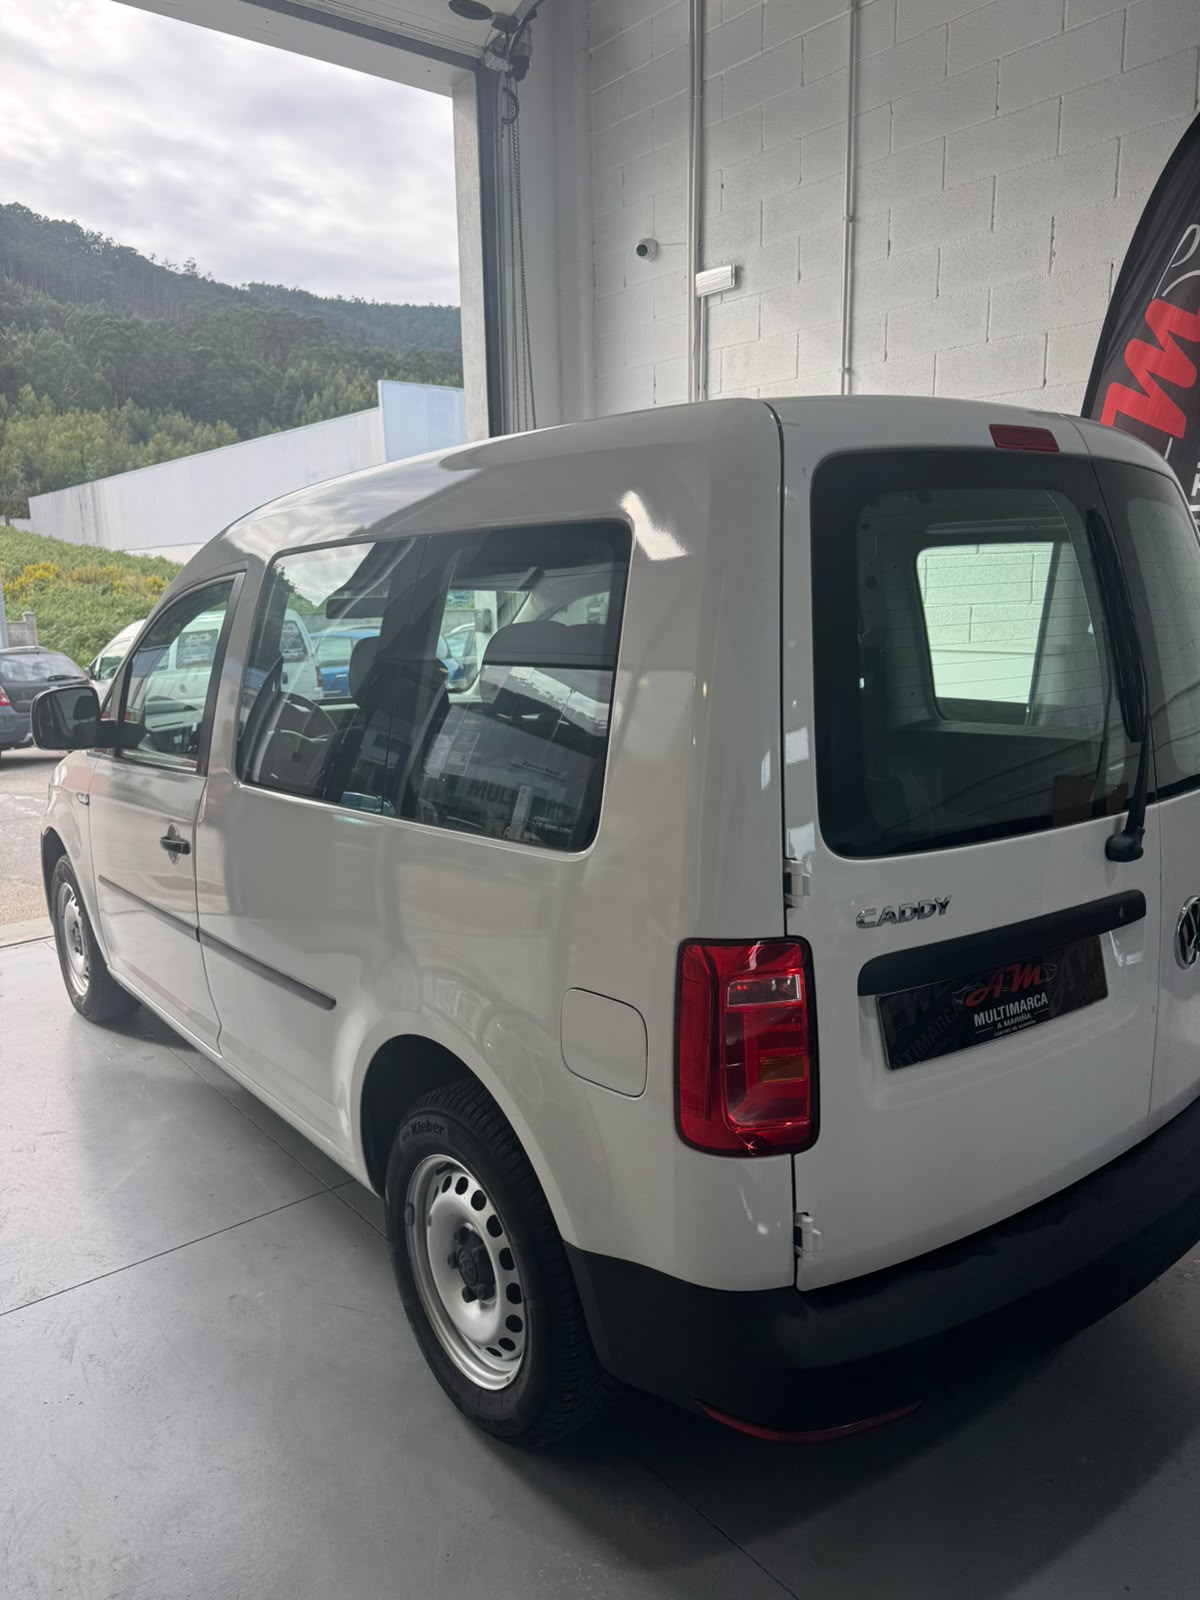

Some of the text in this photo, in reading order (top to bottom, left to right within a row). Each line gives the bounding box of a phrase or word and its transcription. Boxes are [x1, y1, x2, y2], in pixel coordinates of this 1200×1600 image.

[855, 895, 952, 929] CADDY
[964, 963, 1042, 1007] AM
[973, 991, 1049, 1027] MULTIMARCA
[996, 1022, 1003, 1030] A
[411, 1120, 445, 1136] Kleber
